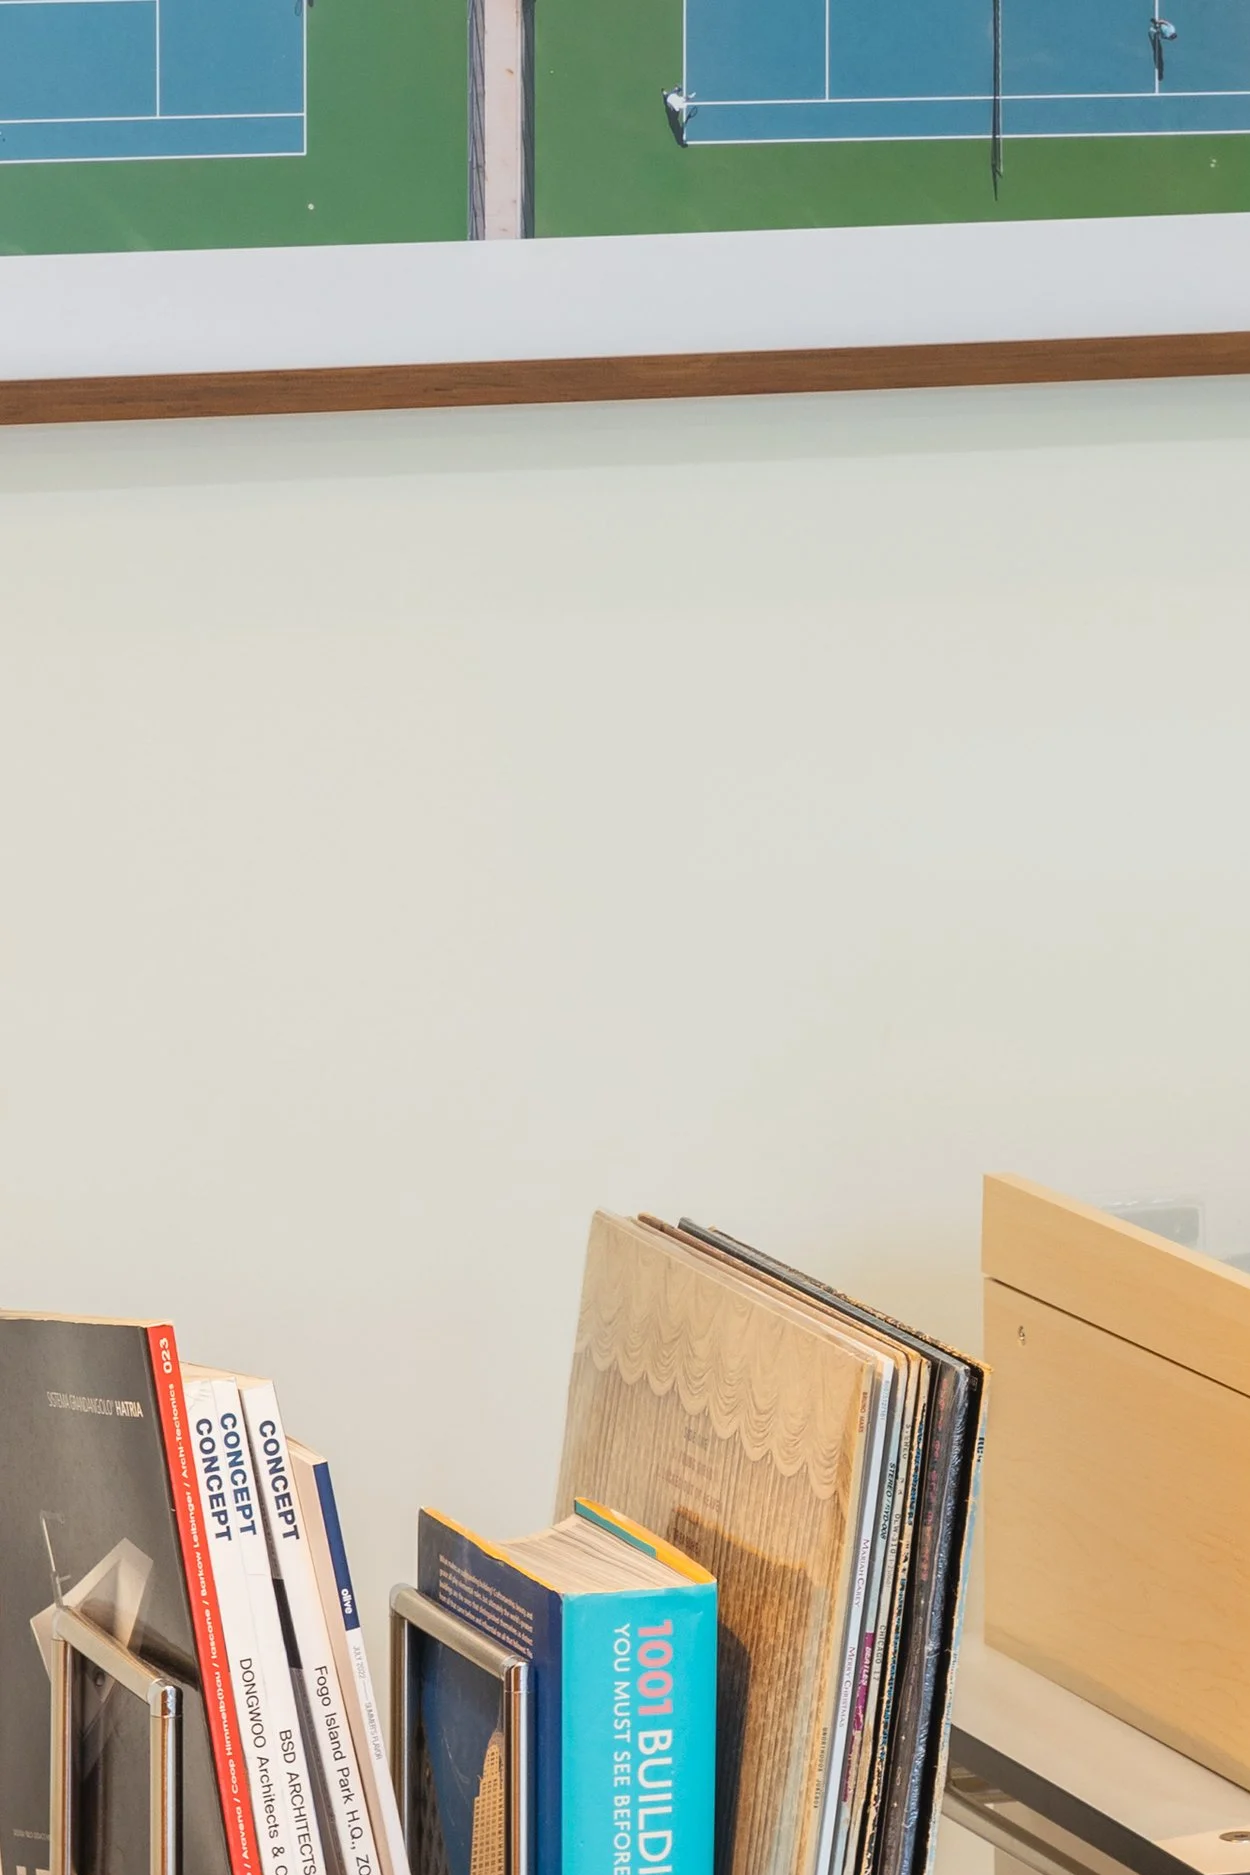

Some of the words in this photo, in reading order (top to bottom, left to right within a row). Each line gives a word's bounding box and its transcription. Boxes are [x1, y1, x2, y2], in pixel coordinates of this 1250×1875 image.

[160, 1337, 173, 1374] 023
[115, 1400, 144, 1418] HATRIA
[168, 1383, 188, 1478] Archi-Tectonics
[196, 1418, 232, 1541] CONCEPT
[220, 1412, 257, 1536] CONCEPT
[259, 1420, 300, 1540] CONCEPT
[885, 1463, 896, 1498] STEREO
[185, 1491, 199, 1548] Leibinger
[195, 1551, 207, 1597] Barkow
[341, 1588, 352, 1614] olive
[613, 1624, 631, 1673] YOU
[873, 1624, 886, 1664] CHICAGO
[314, 1665, 332, 1708] Fogo
[637, 1619, 673, 1716] 1001
[613, 1680, 631, 1743] MUST
[239, 1657, 267, 1749] DONGWOO
[256, 1755, 280, 1840] Architects
[271, 1846, 285, 1858] &
[279, 1729, 297, 1765] BSD
[325, 1712, 346, 1762] Island
[229, 1759, 239, 1795] Coop
[337, 1767, 357, 1805] Park
[613, 1751, 631, 1788] SEE
[236, 1805, 249, 1860] Aravena
[346, 1809, 364, 1850] H.Q.,
